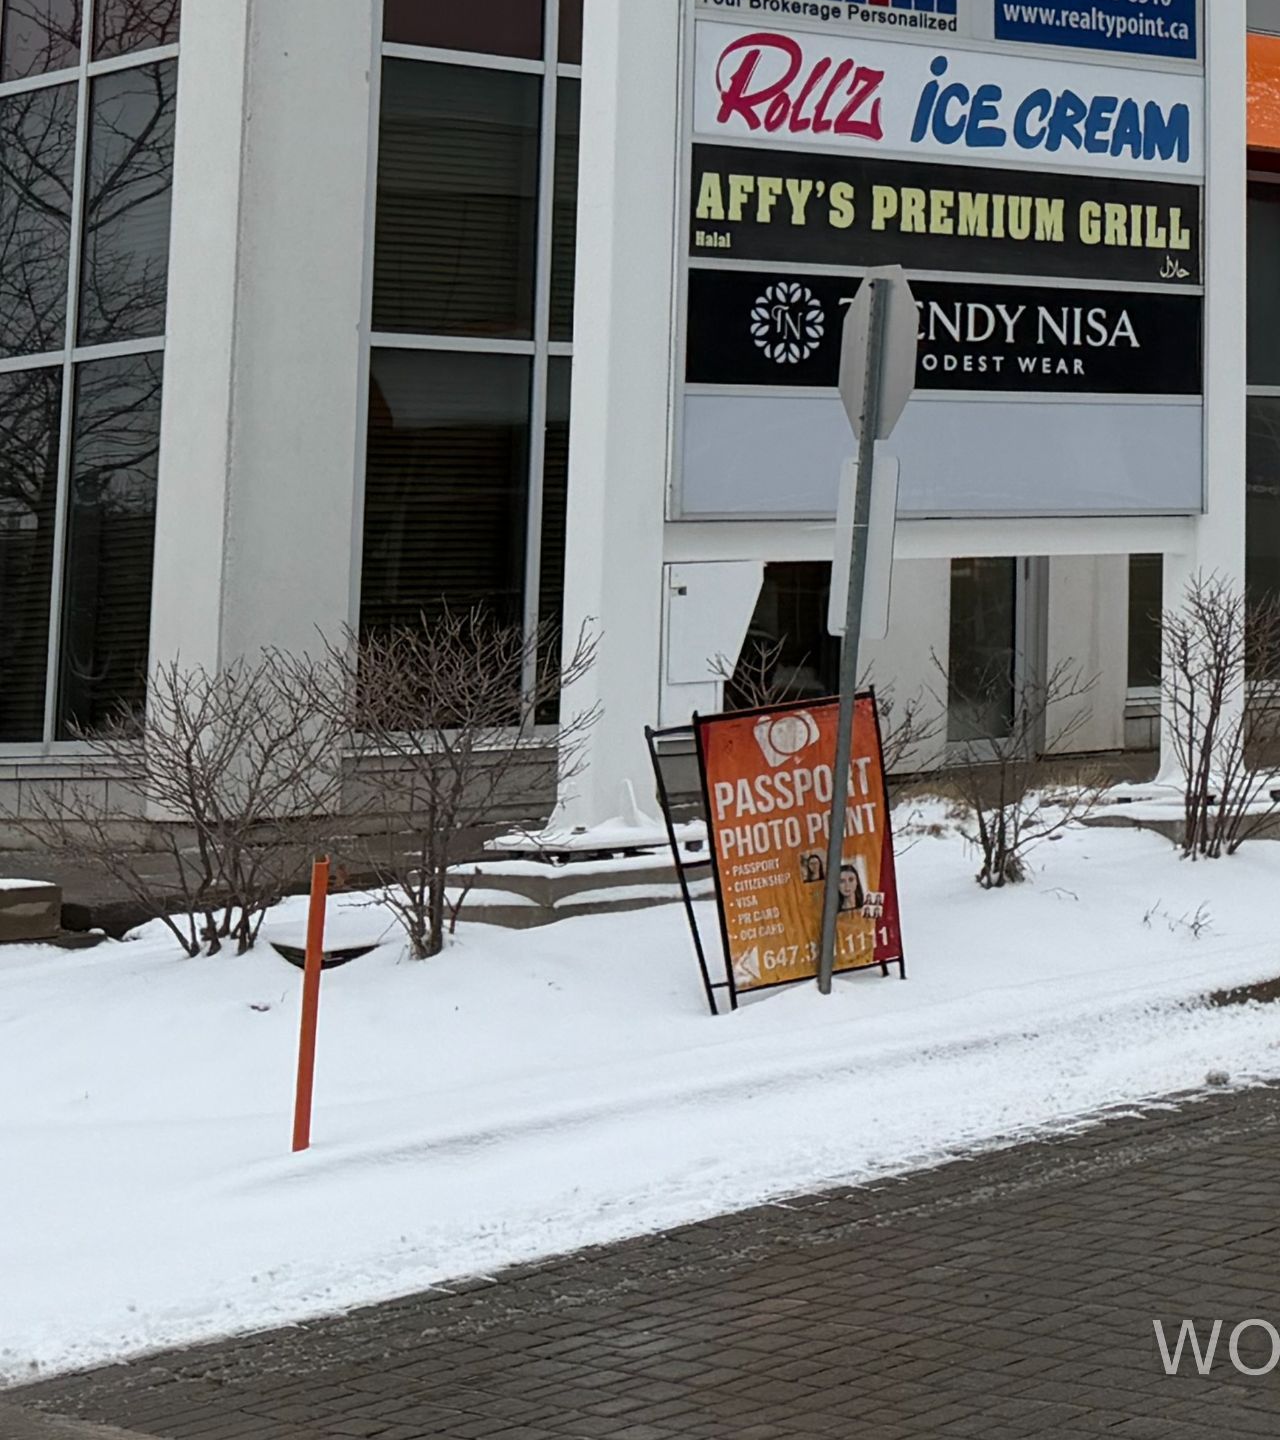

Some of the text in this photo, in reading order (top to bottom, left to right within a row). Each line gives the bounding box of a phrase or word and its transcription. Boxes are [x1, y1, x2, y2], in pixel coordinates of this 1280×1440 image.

[849, 4, 957, 32] Personalized
[1003, 3, 1190, 40] www.realtypoint.ca
[1013, 88, 1191, 162] CREAM
[871, 184, 1065, 243] PREMIUM
[1078, 200, 1191, 250] GRILL
[695, 230, 731, 248] Halal
[1036, 306, 1141, 348] NISA
[921, 353, 1086, 375] ODEST WEAR
[719, 816, 801, 860] PHOTO
[732, 858, 780, 877] PASSPORT
[734, 872, 791, 893] CITIZENSHIP
[736, 894, 758, 909] VISA
